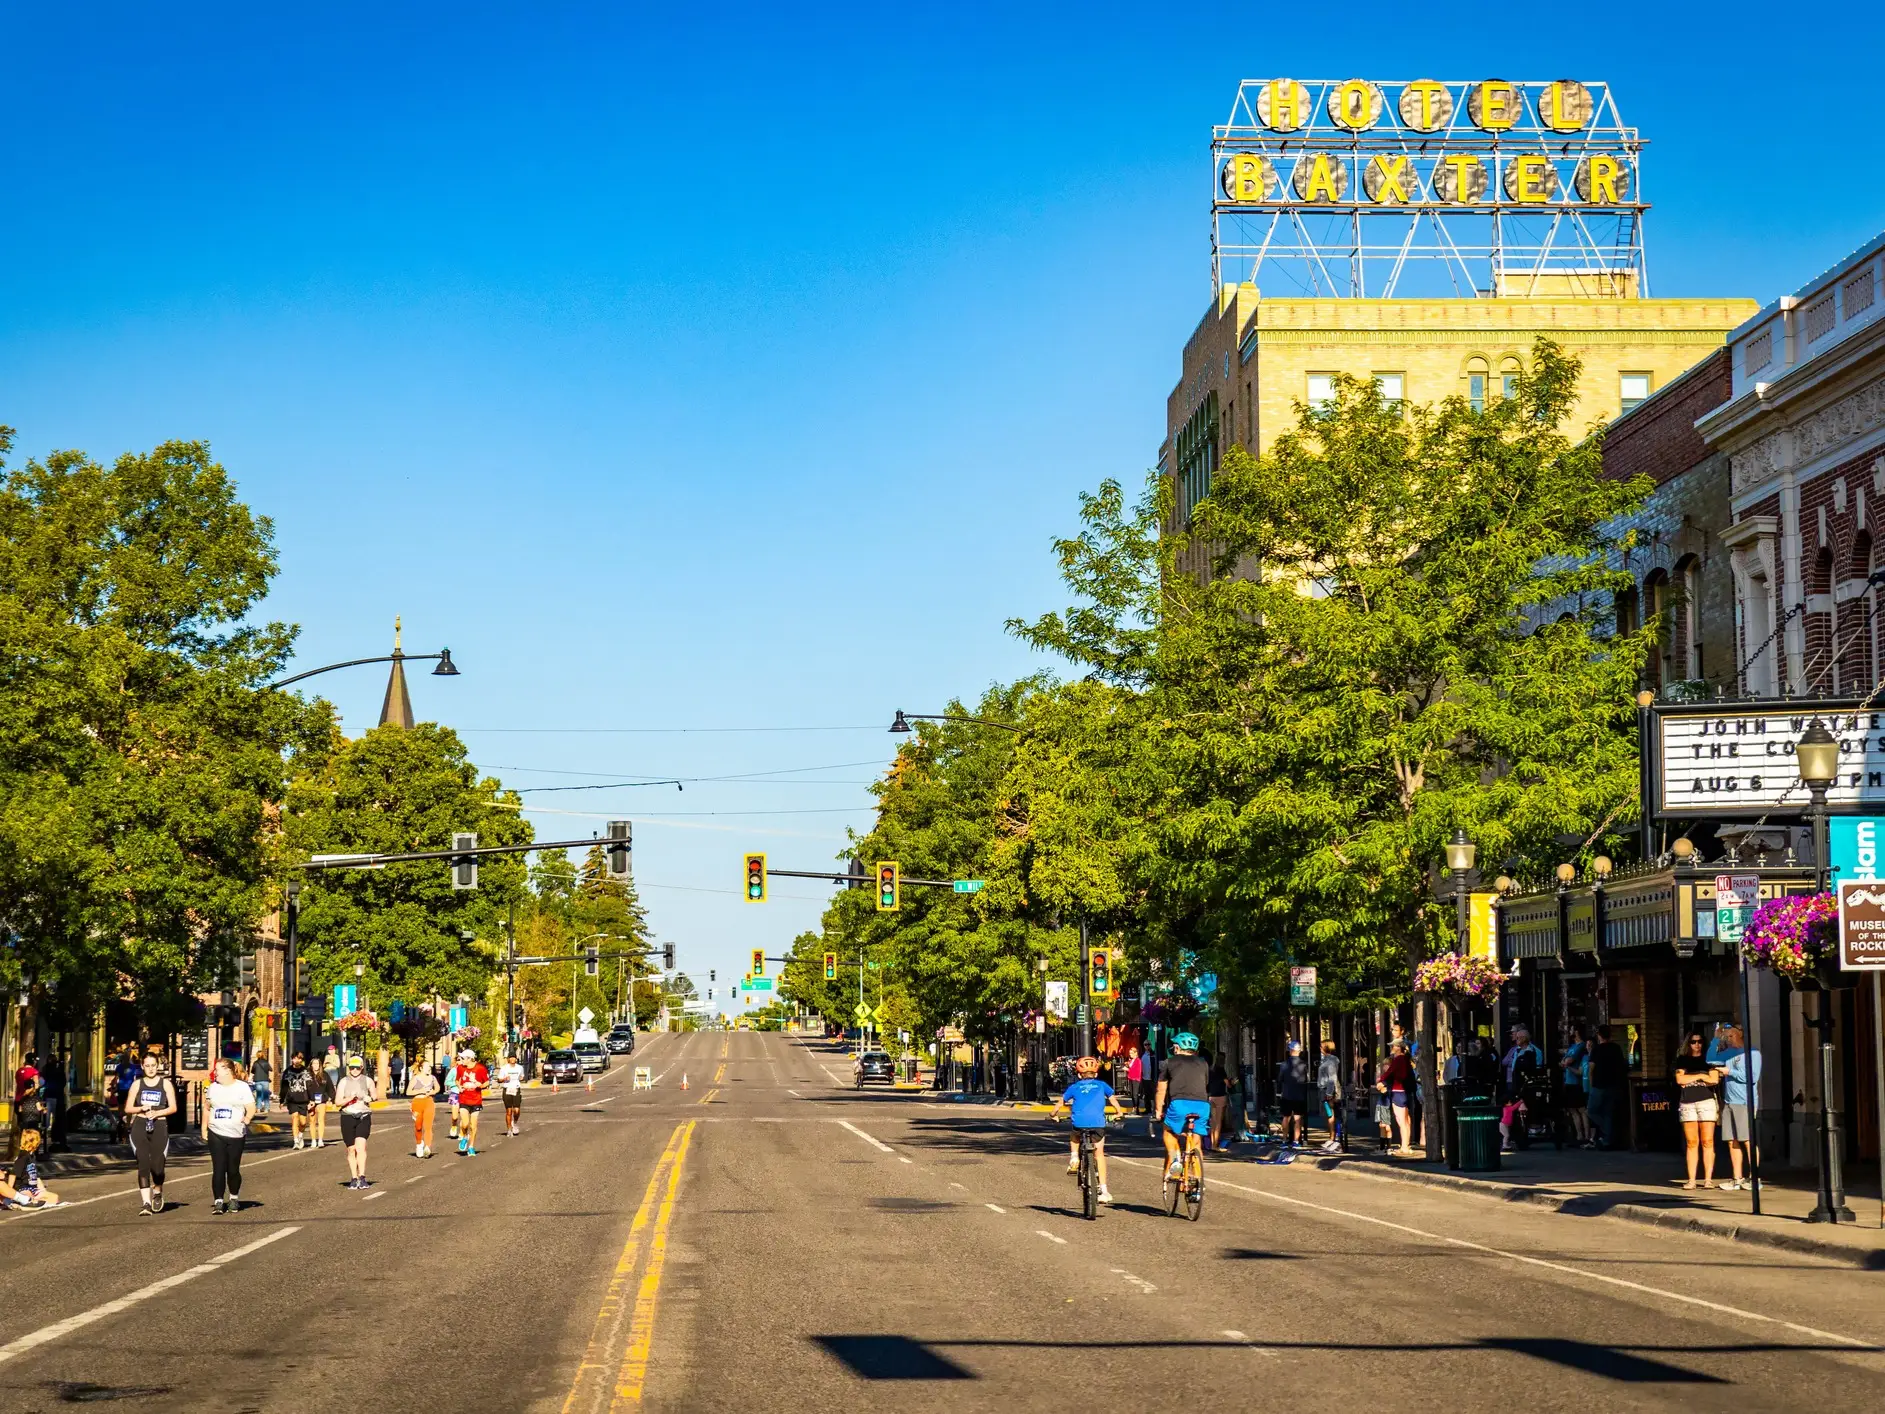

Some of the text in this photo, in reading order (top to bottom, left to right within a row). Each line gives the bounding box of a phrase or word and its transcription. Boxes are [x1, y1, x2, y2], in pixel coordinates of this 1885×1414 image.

[1270, 82, 1582, 129] HOTEL
[1235, 154, 1619, 203] BAXTER
[1698, 714, 1880, 737] JOHN WYNE
[1692, 737, 1885, 759] THE COOYS
[1692, 776, 1738, 794] AUG
[1750, 775, 1763, 792] 6
[1718, 877, 1757, 891] NO PARKING
[1721, 910, 1730, 923] 2
[1857, 932, 1870, 940] OF
